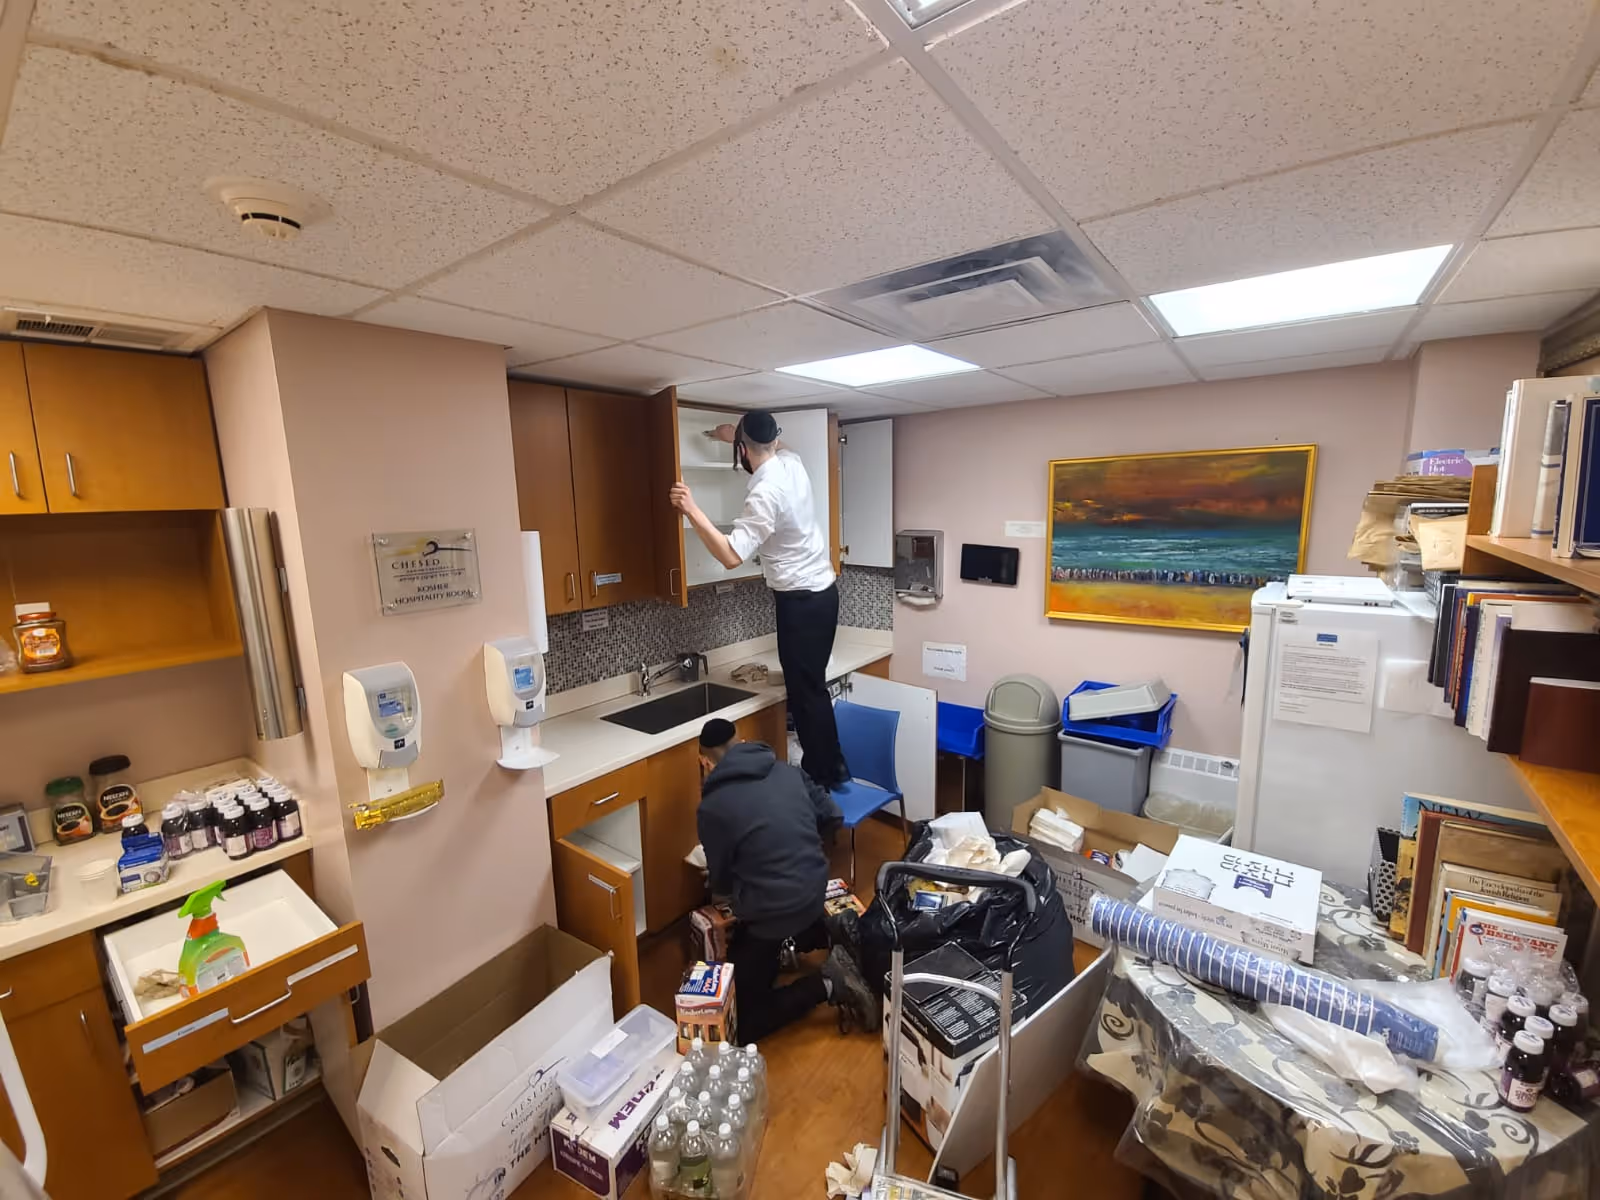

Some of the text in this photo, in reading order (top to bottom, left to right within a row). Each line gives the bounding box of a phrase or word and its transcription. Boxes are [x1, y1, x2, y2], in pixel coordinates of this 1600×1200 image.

[1429, 457, 1464, 465] Electric
[1428, 465, 1445, 473] Hot
[391, 559, 440, 570] CHESED
[417, 583, 449, 593] KOSHER
[395, 589, 474, 605] HOSPITALITY ROOM
[511, 1143, 532, 1169] THE
